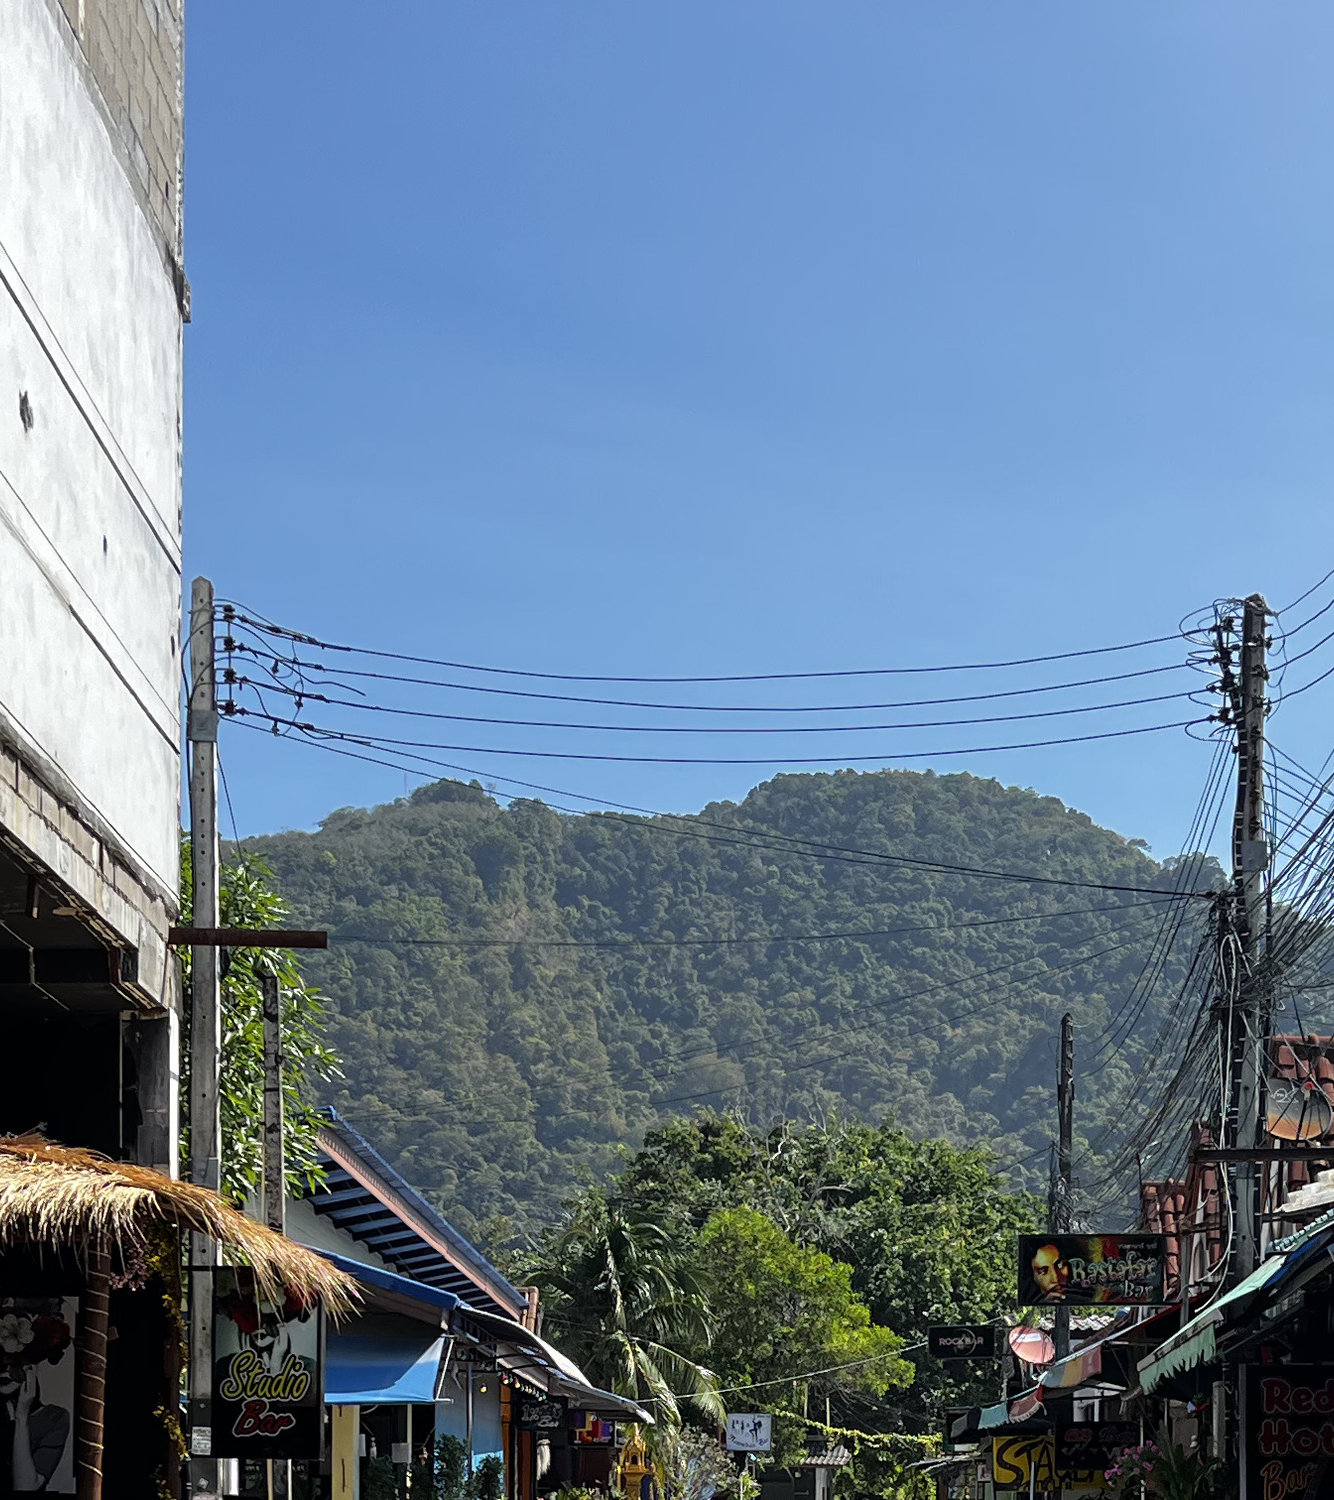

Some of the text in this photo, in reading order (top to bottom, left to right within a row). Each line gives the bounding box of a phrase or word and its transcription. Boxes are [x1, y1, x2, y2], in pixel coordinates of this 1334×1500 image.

[1122, 1280, 1154, 1298] Bar
[220, 1349, 310, 1401] Studio
[232, 1400, 295, 1437] Bar
